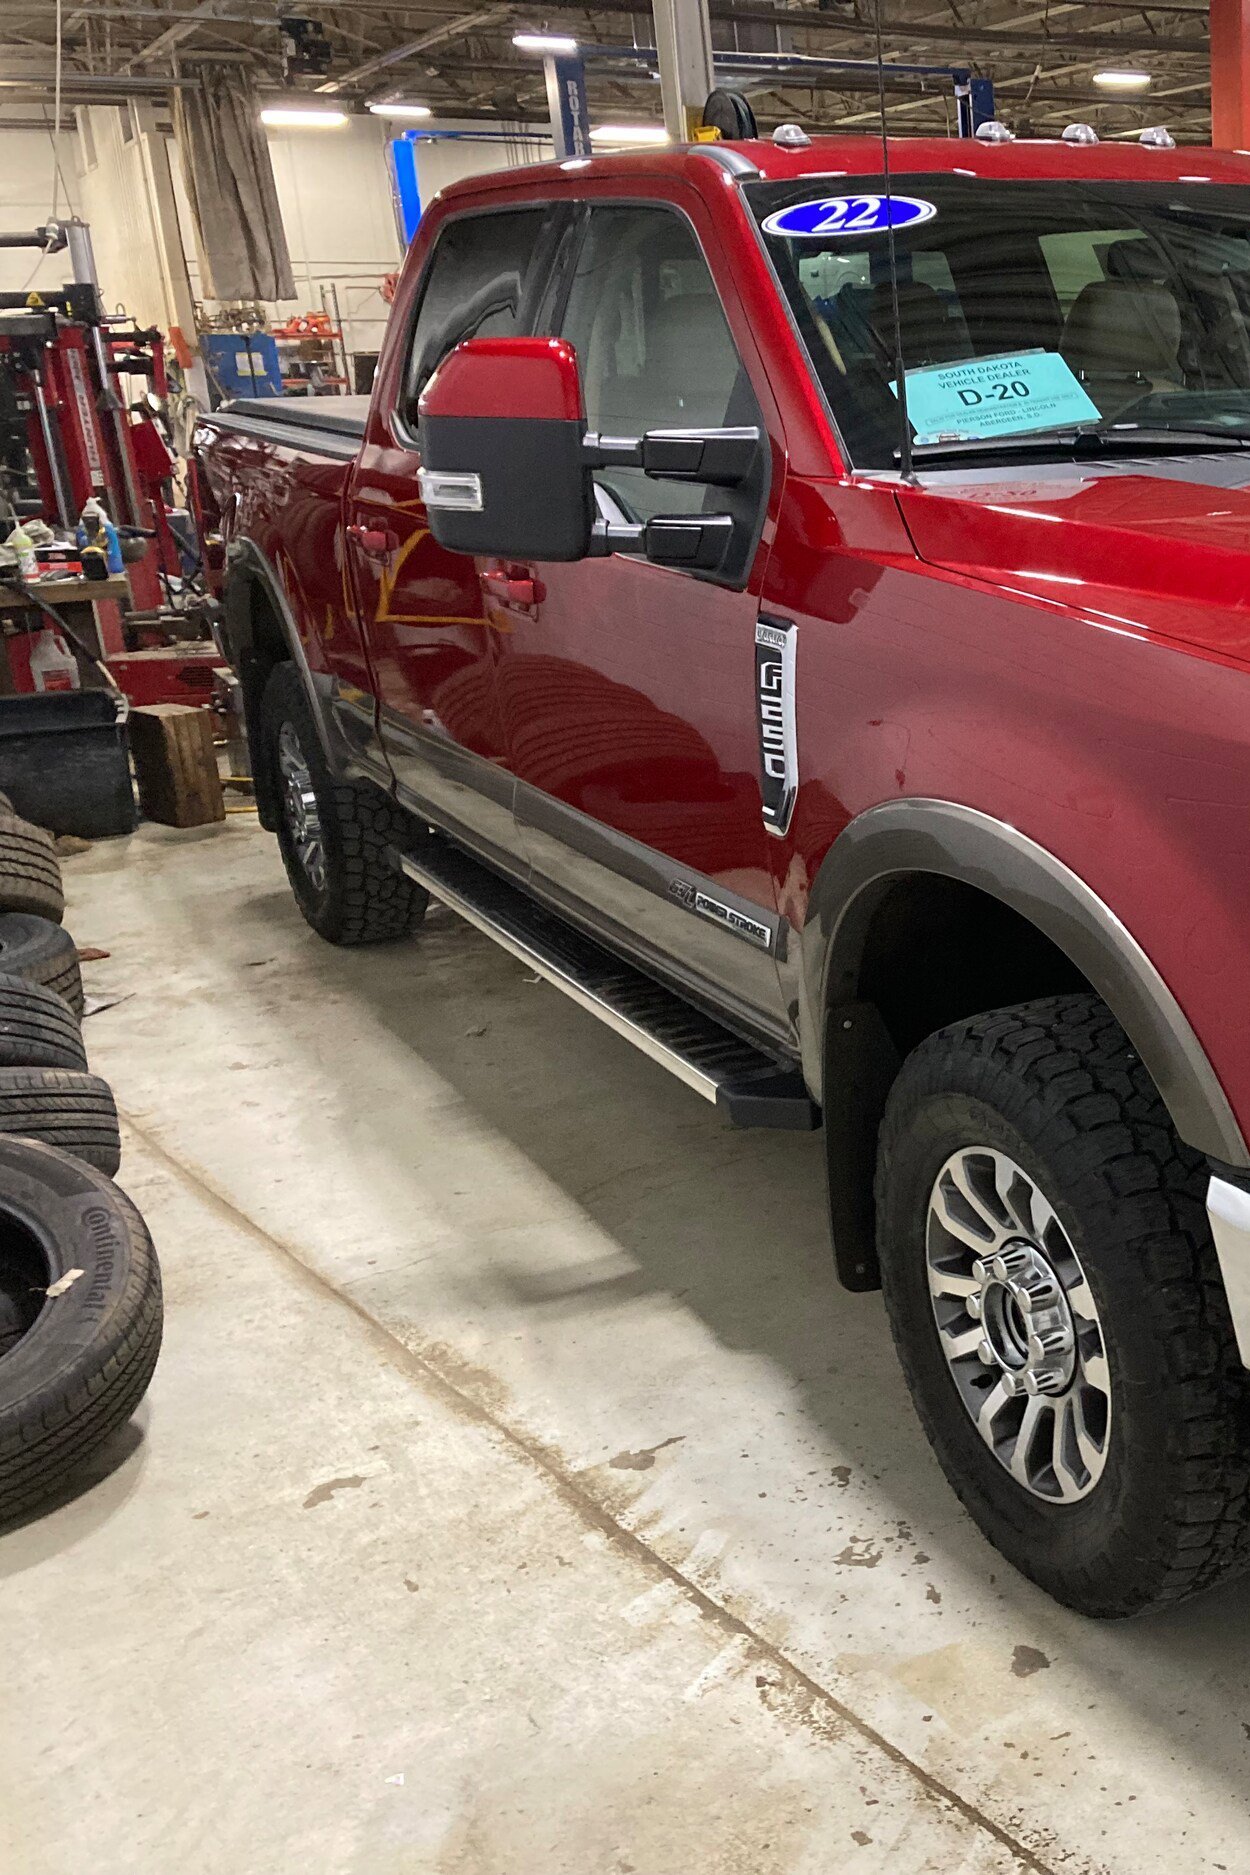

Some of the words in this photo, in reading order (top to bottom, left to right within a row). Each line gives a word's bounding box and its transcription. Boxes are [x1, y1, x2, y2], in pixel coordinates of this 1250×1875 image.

[811, 197, 882, 232] 22
[937, 367, 975, 381] SOUTH
[976, 360, 1023, 375] DAKOTA
[938, 376, 986, 390] VEHICLE
[987, 368, 1031, 381] DEALER
[957, 380, 1030, 407] D-20
[956, 412, 993, 425] PIERSON
[994, 409, 1017, 421] FORD
[1022, 402, 1057, 414] LINCOLN
[697, 895, 728, 920] POWER
[728, 912, 767, 940] STROKE
[81, 1206, 120, 1309] Continental
